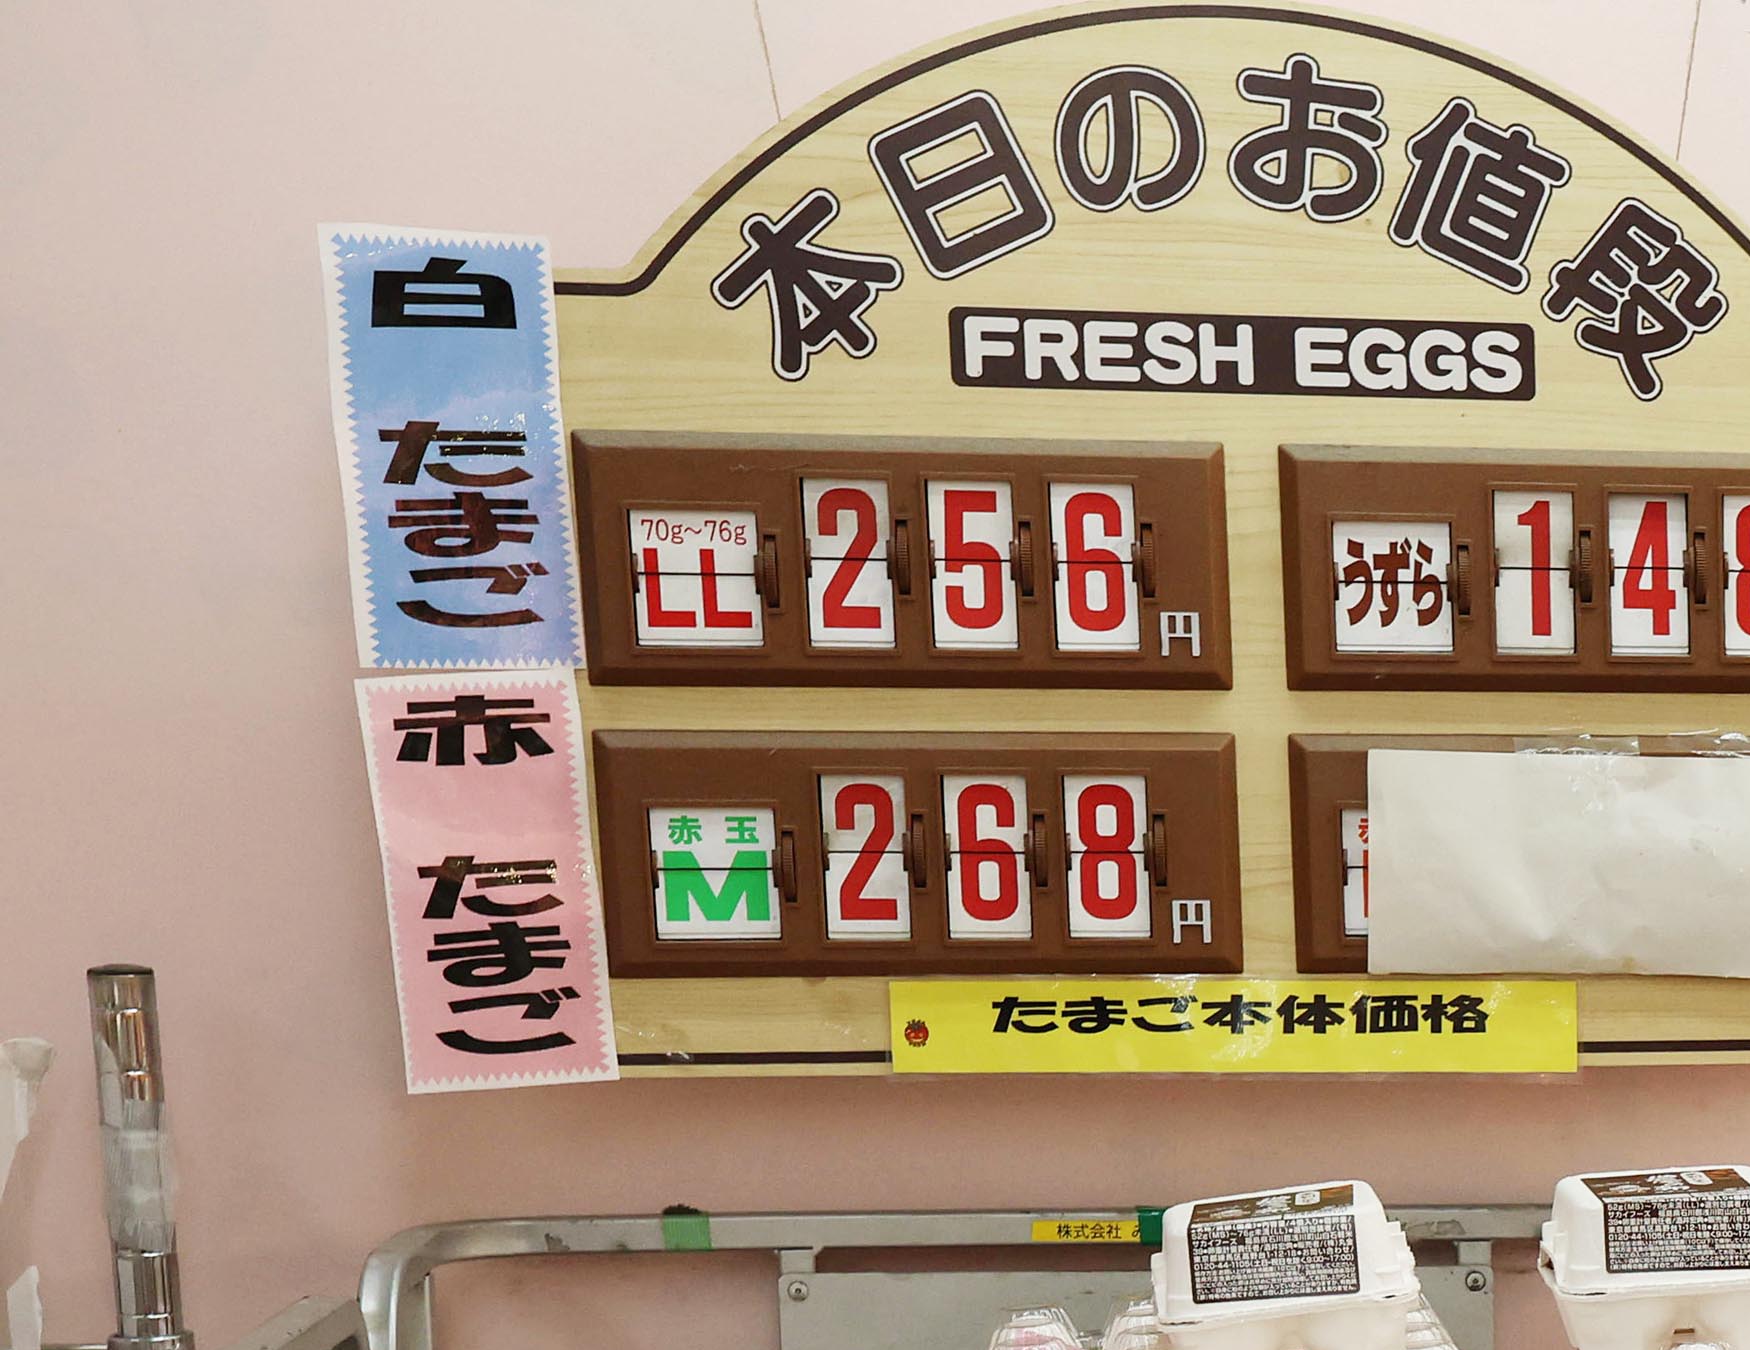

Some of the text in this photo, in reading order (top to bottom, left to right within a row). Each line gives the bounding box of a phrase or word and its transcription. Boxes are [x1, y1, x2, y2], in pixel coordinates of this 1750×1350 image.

[711, 53, 1728, 401] 本日のお値段
[963, 316, 1523, 392] FRESH EGGS
[371, 257, 545, 628] 白 たまご
[642, 548, 754, 628] LL
[1343, 540, 1443, 627] うずら
[668, 816, 759, 845] 赤玉
[393, 696, 576, 1055] 赤 たまご
[663, 852, 770, 921] M
[991, 993, 1490, 1034] たまご本体価格
[1057, 1223, 1122, 1240] 株式会社
